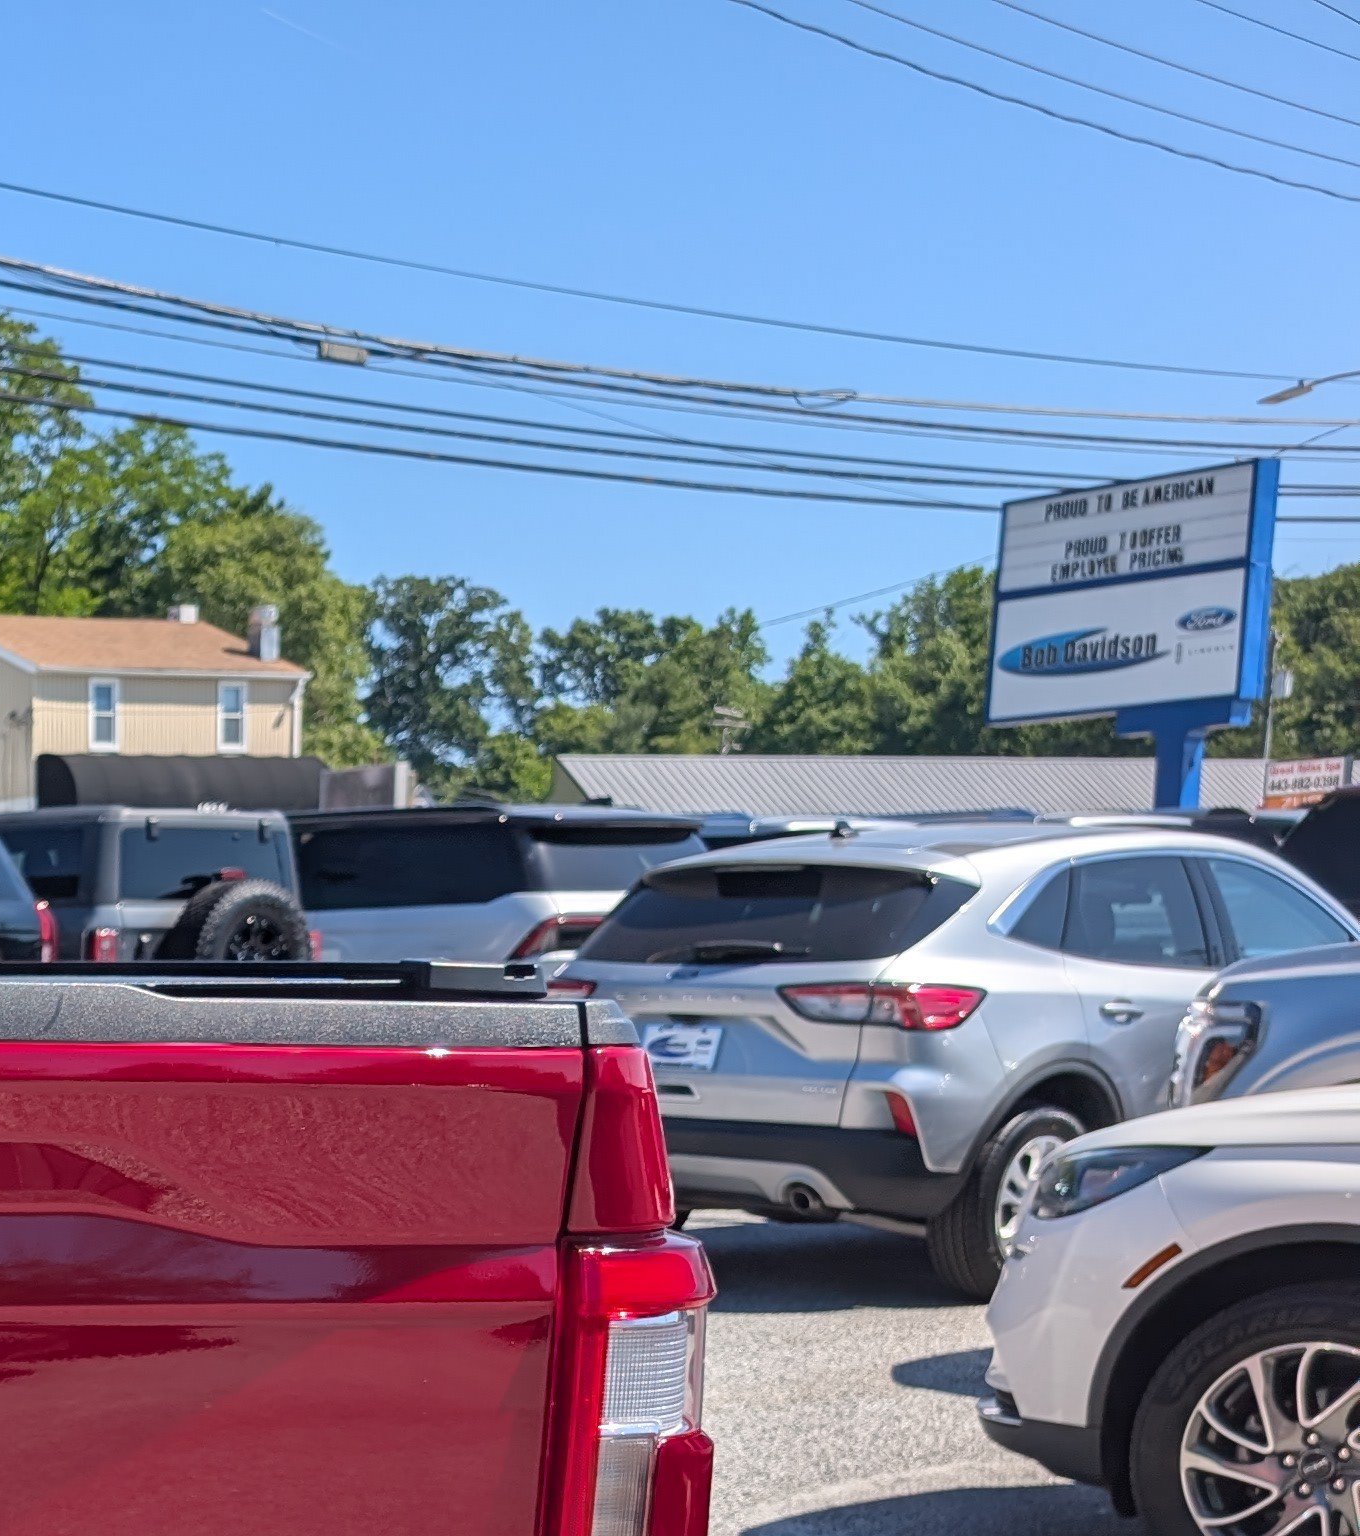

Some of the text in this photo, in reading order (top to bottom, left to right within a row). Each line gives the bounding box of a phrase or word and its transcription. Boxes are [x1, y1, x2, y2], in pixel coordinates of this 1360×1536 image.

[1044, 476, 1215, 522] PROUD TO BE AMERICAN
[1049, 547, 1185, 583] EMPLOYEE PRICING
[1064, 535, 1108, 559] PROUD
[1020, 632, 1158, 668] Bob Davidson
